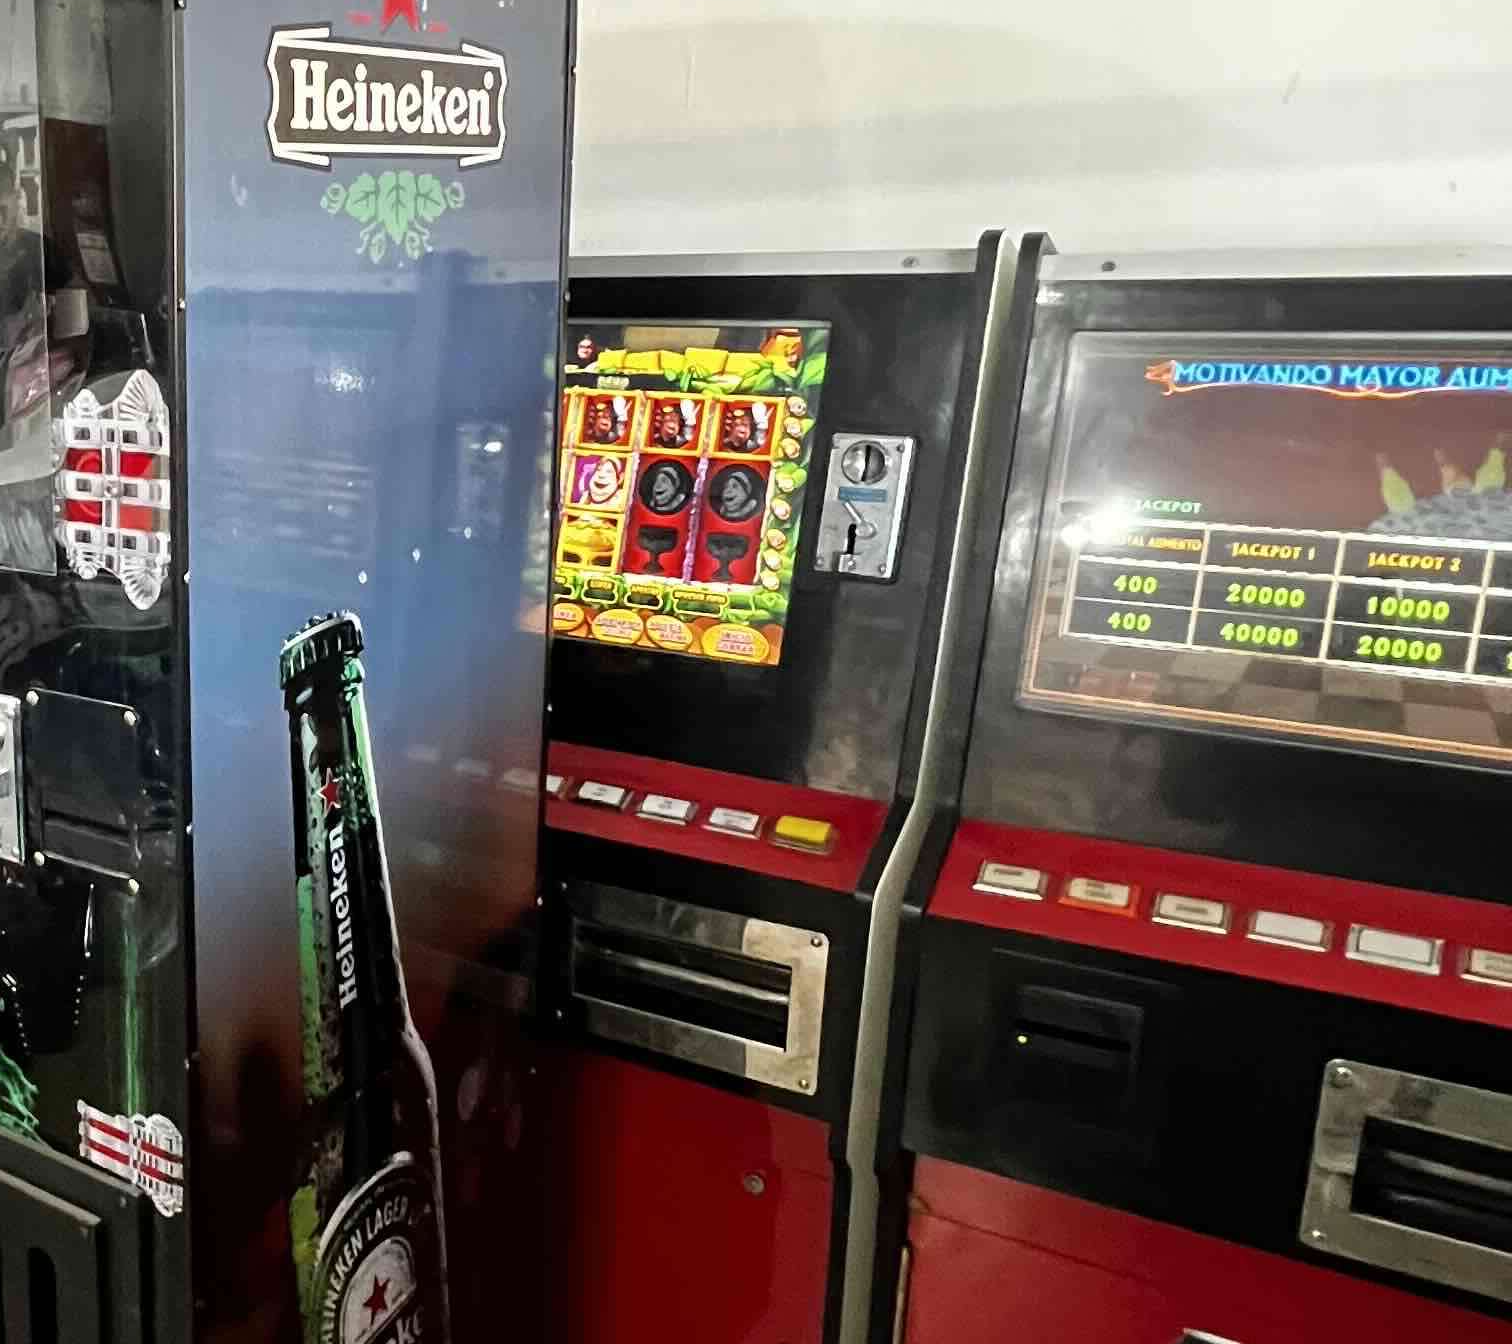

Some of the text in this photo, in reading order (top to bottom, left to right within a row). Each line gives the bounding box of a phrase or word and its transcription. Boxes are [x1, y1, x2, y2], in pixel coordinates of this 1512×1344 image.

[289, 58, 492, 136] Heineken
[1174, 361, 1332, 385] MOTIVANDO
[1339, 365, 1440, 388] MAYOR
[1231, 541, 1316, 561] JACKPOT 1
[1367, 551, 1445, 572] JACKPOT
[1113, 574, 1159, 595] 400
[1225, 583, 1306, 608] 20000
[1106, 611, 1152, 633] 400
[1367, 596, 1450, 623] 10000
[1219, 622, 1299, 648] 40000
[1356, 634, 1443, 663] 20000
[329, 820, 359, 1009] Heineken
